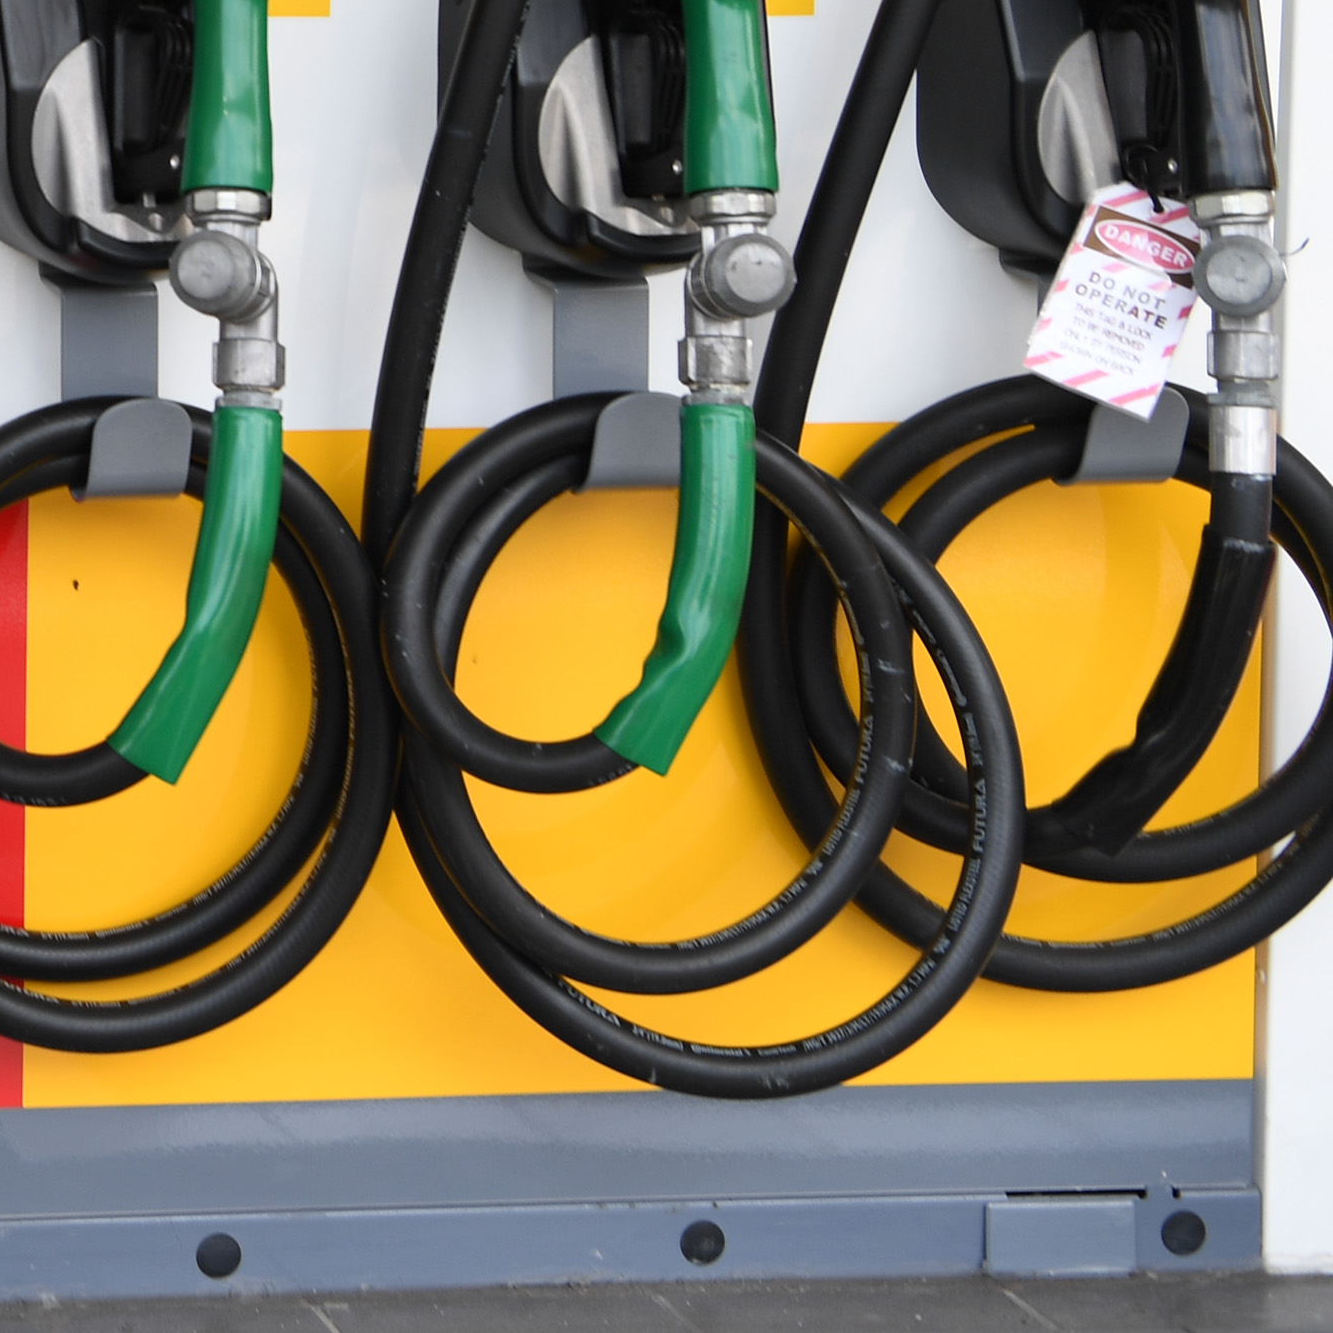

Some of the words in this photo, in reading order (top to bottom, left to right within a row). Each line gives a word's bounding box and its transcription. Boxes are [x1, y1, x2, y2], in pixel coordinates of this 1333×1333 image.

[1104, 224, 1188, 268] DANGER
[1075, 283, 1168, 329] OPERATE
[1089, 271, 1115, 290] DO
[1123, 285, 1166, 310] NOT
[854, 715, 874, 784] FUTURA
[973, 778, 988, 853] FUTURA
